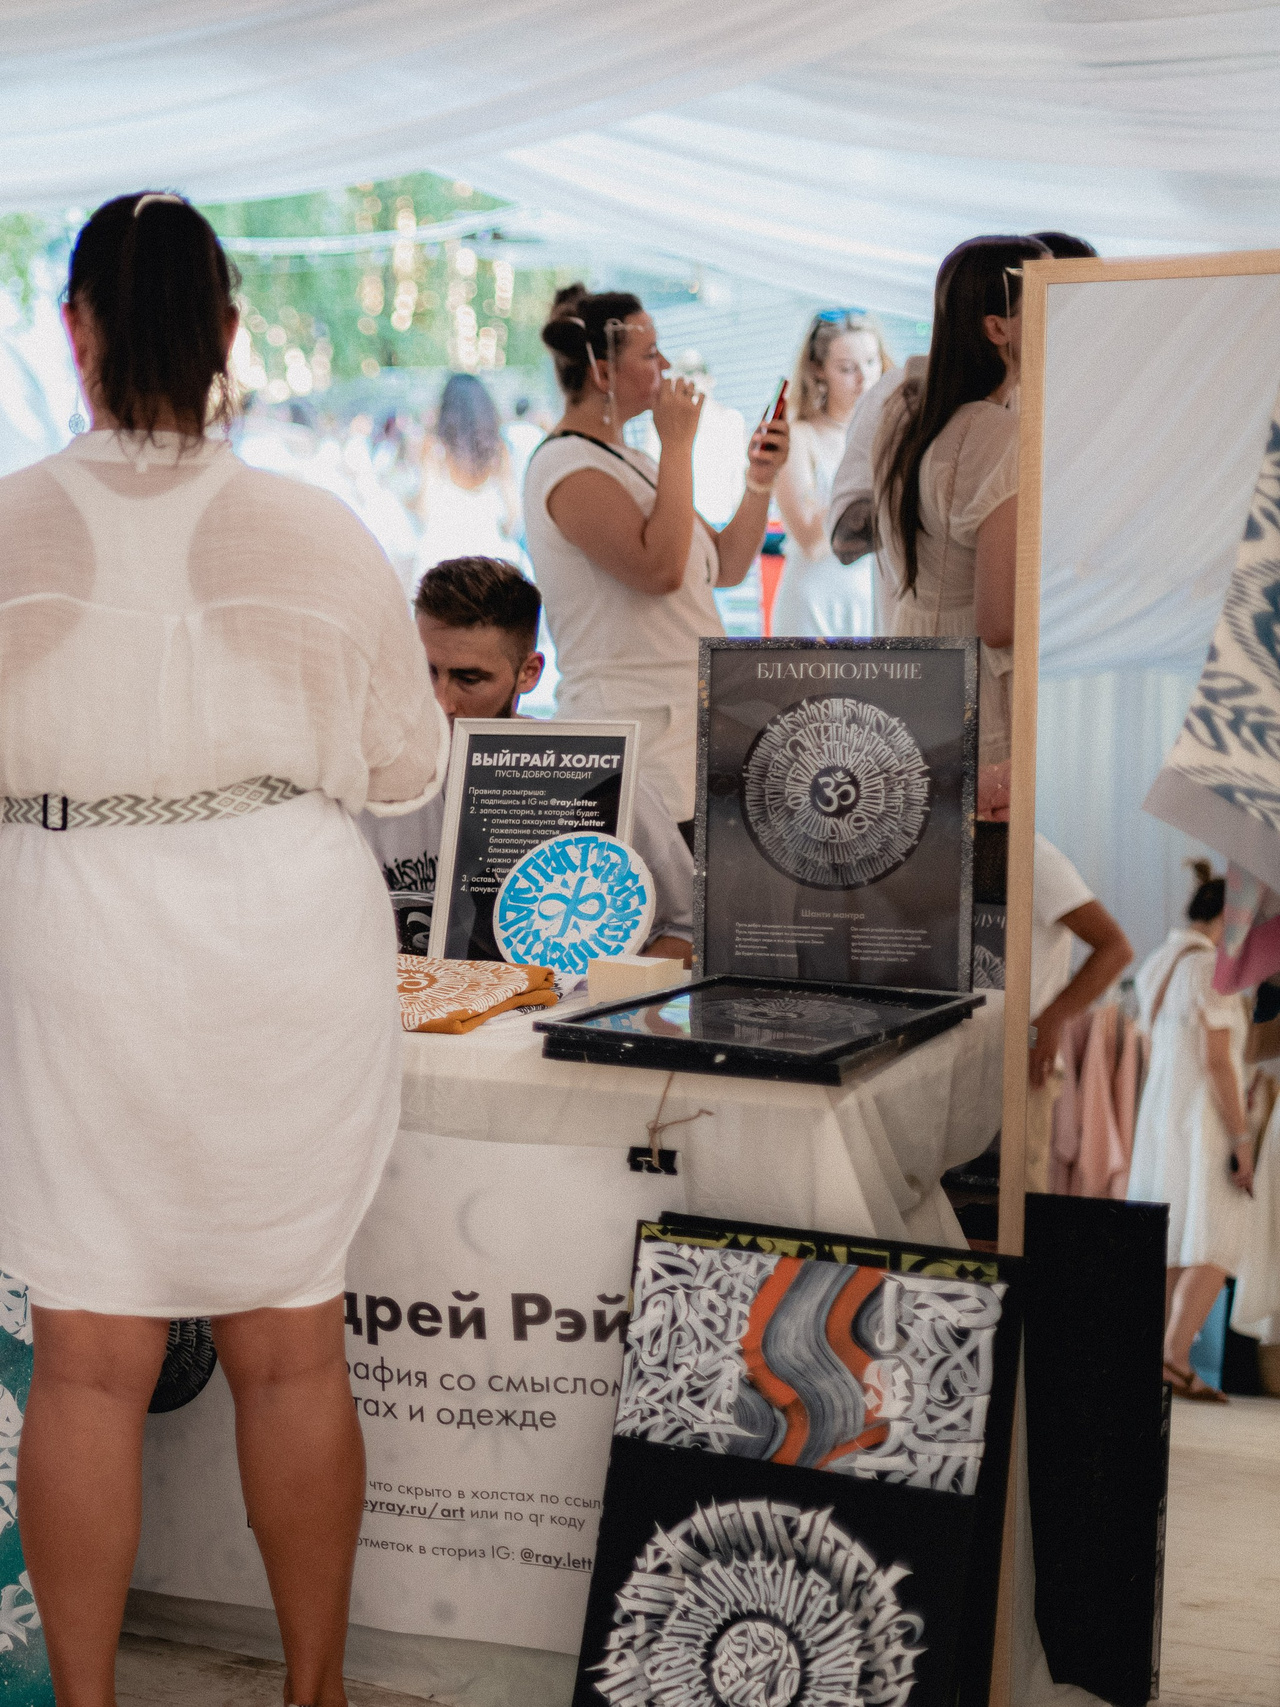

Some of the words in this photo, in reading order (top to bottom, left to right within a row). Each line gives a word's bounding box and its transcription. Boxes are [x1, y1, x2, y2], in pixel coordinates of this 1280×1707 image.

[756, 662, 922, 680] БЛАГОПОЛУЧИЕ
[471, 749, 556, 768] ВЫЙГРАЙ
[559, 753, 621, 769] ХОЛСТ
[495, 769, 521, 779] ПУСТЬ
[521, 770, 552, 779] ДОБРО
[553, 771, 593, 780] ПОБЕДИТ
[468, 786, 501, 796] Правила
[502, 788, 547, 797] розыгрыша:
[480, 798, 520, 806] подпишись
[549, 798, 598, 808] @ray.letter
[469, 806, 477, 814] 2.
[544, 809, 575, 817] которой
[576, 808, 600, 818] будет:
[522, 819, 556, 827] аккаунта
[557, 818, 606, 828] @ray.letter
[489, 836, 540, 846] благополучия
[487, 846, 519, 854] близким
[461, 874, 469, 883] 3.
[460, 884, 468, 892] 4.
[801, 909, 831, 918] Шанти
[833, 911, 865, 921] мантра
[511, 1292, 630, 1344] Рэй
[439, 1372, 477, 1392] со
[408, 1404, 425, 1423] и
[436, 1407, 557, 1432] одежде
[369, 1480, 393, 1493] что
[397, 1484, 452, 1500] скрыто
[457, 1490, 466, 1499] в
[471, 1490, 536, 1503] холстах
[540, 1494, 559, 1505] по
[470, 1510, 498, 1520] или
[504, 1511, 524, 1522] по
[550, 1515, 586, 1532] коду
[418, 1545, 427, 1555] в
[431, 1546, 486, 1561] сториз
[491, 1545, 515, 1561] IG:
